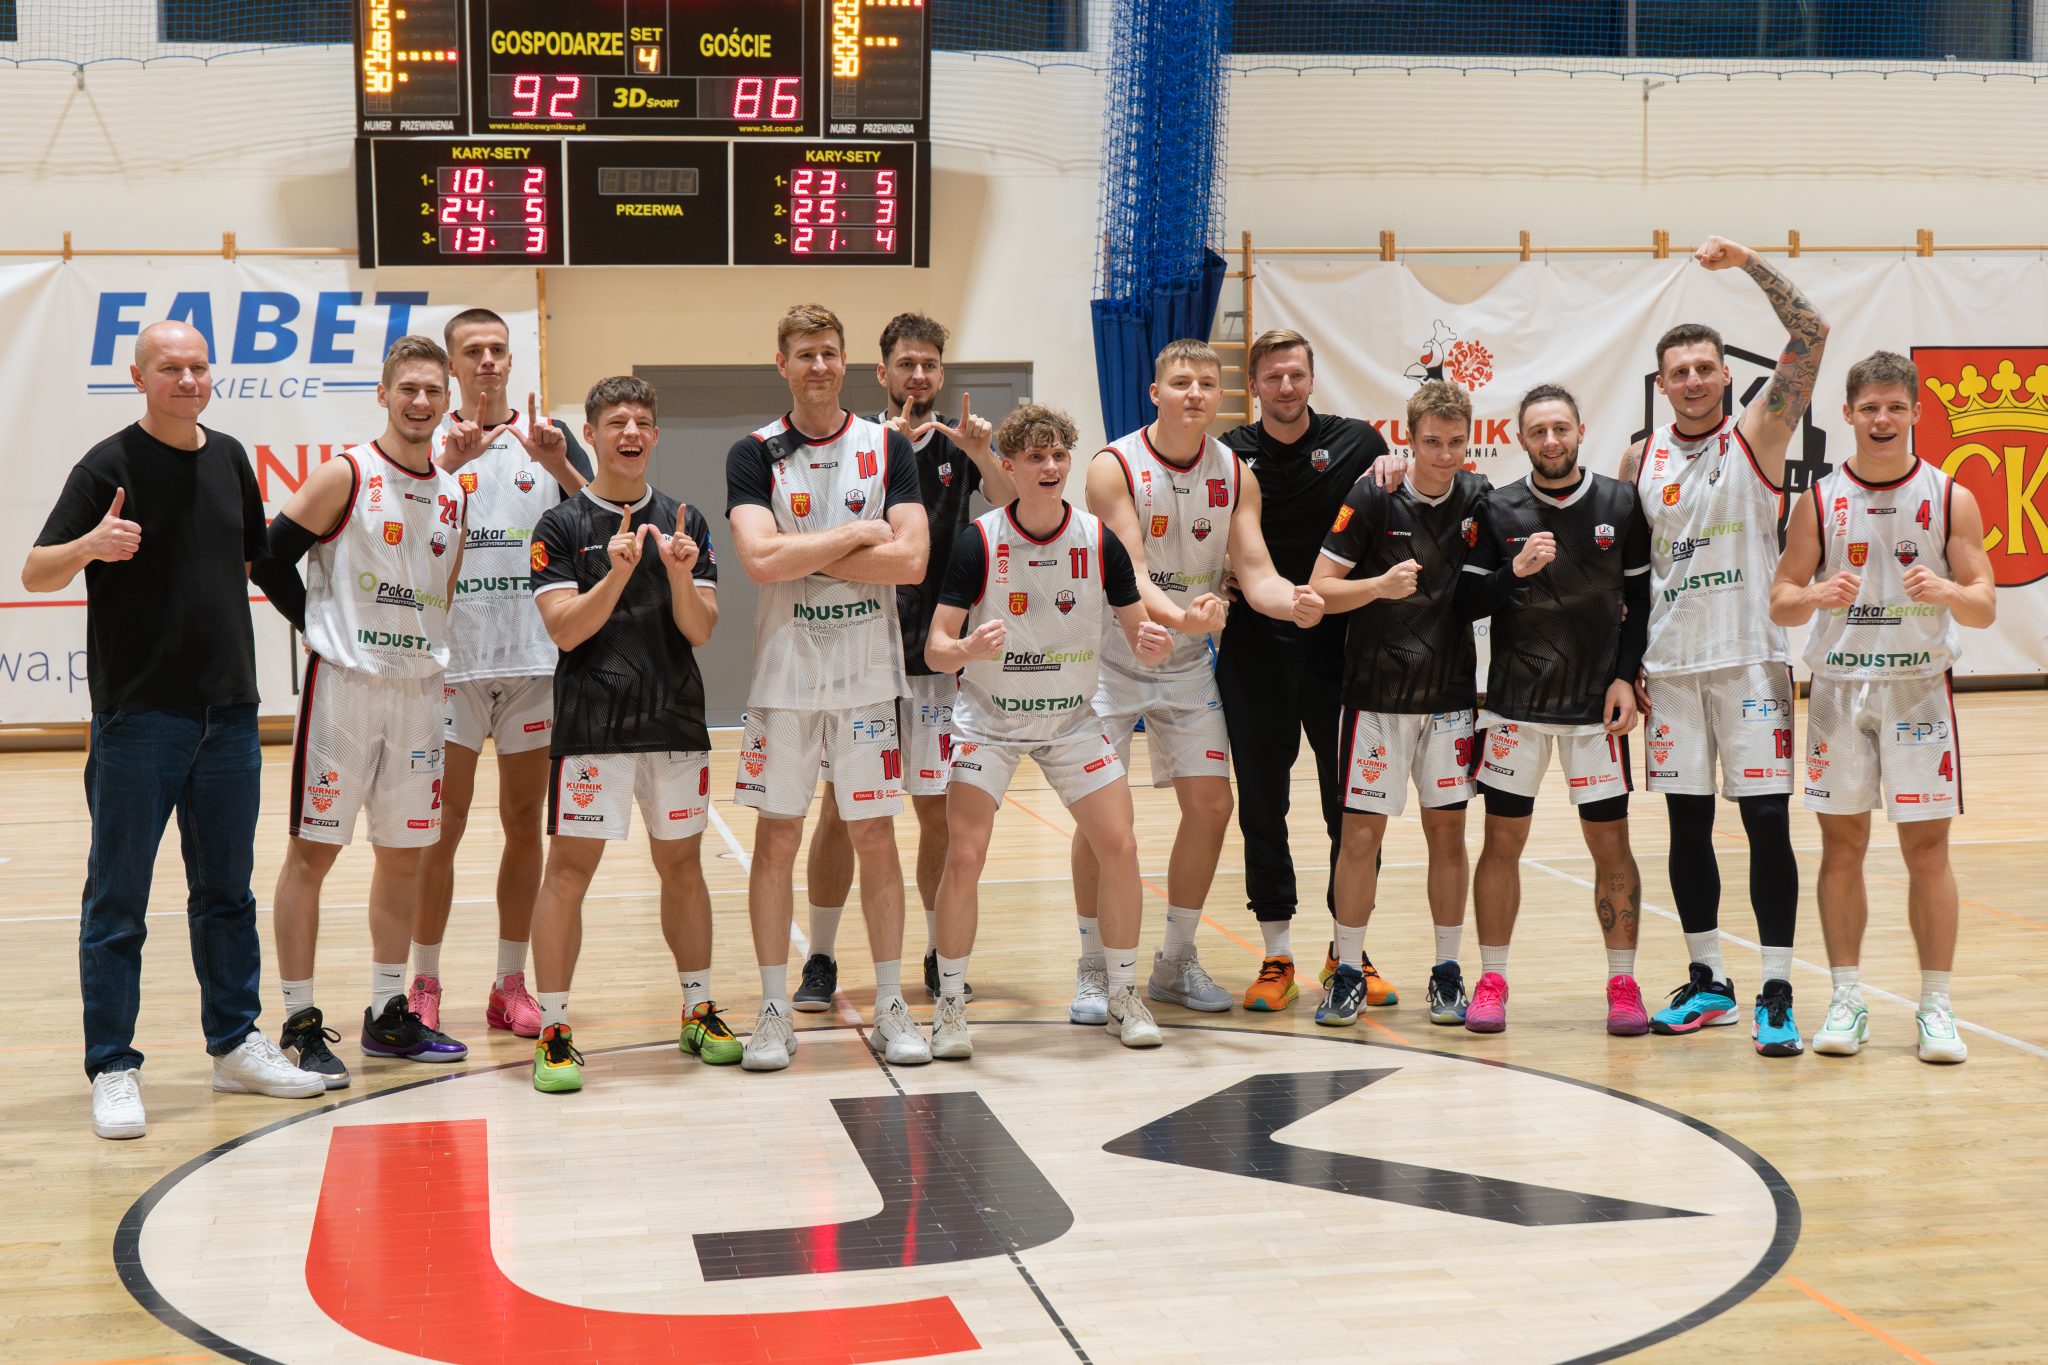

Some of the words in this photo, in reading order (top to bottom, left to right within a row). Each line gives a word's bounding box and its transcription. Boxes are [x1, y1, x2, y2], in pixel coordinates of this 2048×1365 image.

[491, 31, 624, 56] GOSPODARZE
[630, 28, 663, 41] SET
[700, 28, 772, 57] GOŚCIE
[638, 48, 658, 72] 4
[513, 75, 580, 118] 92
[733, 78, 800, 119] 86
[364, 120, 392, 132] NUMER
[400, 121, 455, 132] PRZEWINIENIA
[489, 122, 587, 132] www.tablicewynikow.pl
[739, 124, 804, 134] www.3d.com.pl
[830, 123, 857, 134] NUMER
[863, 123, 915, 134] PRZEWINIENIA
[452, 147, 531, 159] KARY-SETY
[806, 150, 881, 163] KARY-SETY
[616, 204, 684, 217] PRZERWA
[90, 291, 429, 365] FABET
[211, 377, 322, 399] KIELCE
[1366, 419, 1512, 445] KUIK
[855, 450, 878, 479] 10
[1206, 478, 1229, 508] 15
[1916, 499, 1932, 530] 4
[1069, 548, 1089, 578] 11
[456, 576, 532, 594] NDUSTR
[358, 629, 432, 651] INDUST
[1826, 652, 1931, 667] INDUSTRIA
[991, 694, 1083, 712] INDUSTRIA
[1489, 733, 1519, 747] KURNIK
[1773, 728, 1792, 759] 13
[1357, 758, 1388, 769] KURNIK
[1807, 757, 1830, 766] URNIK
[1938, 750, 1953, 781] 4
[308, 785, 341, 796] KURNIK
[431, 779, 444, 810] 2
[566, 782, 602, 791] KURNIK
